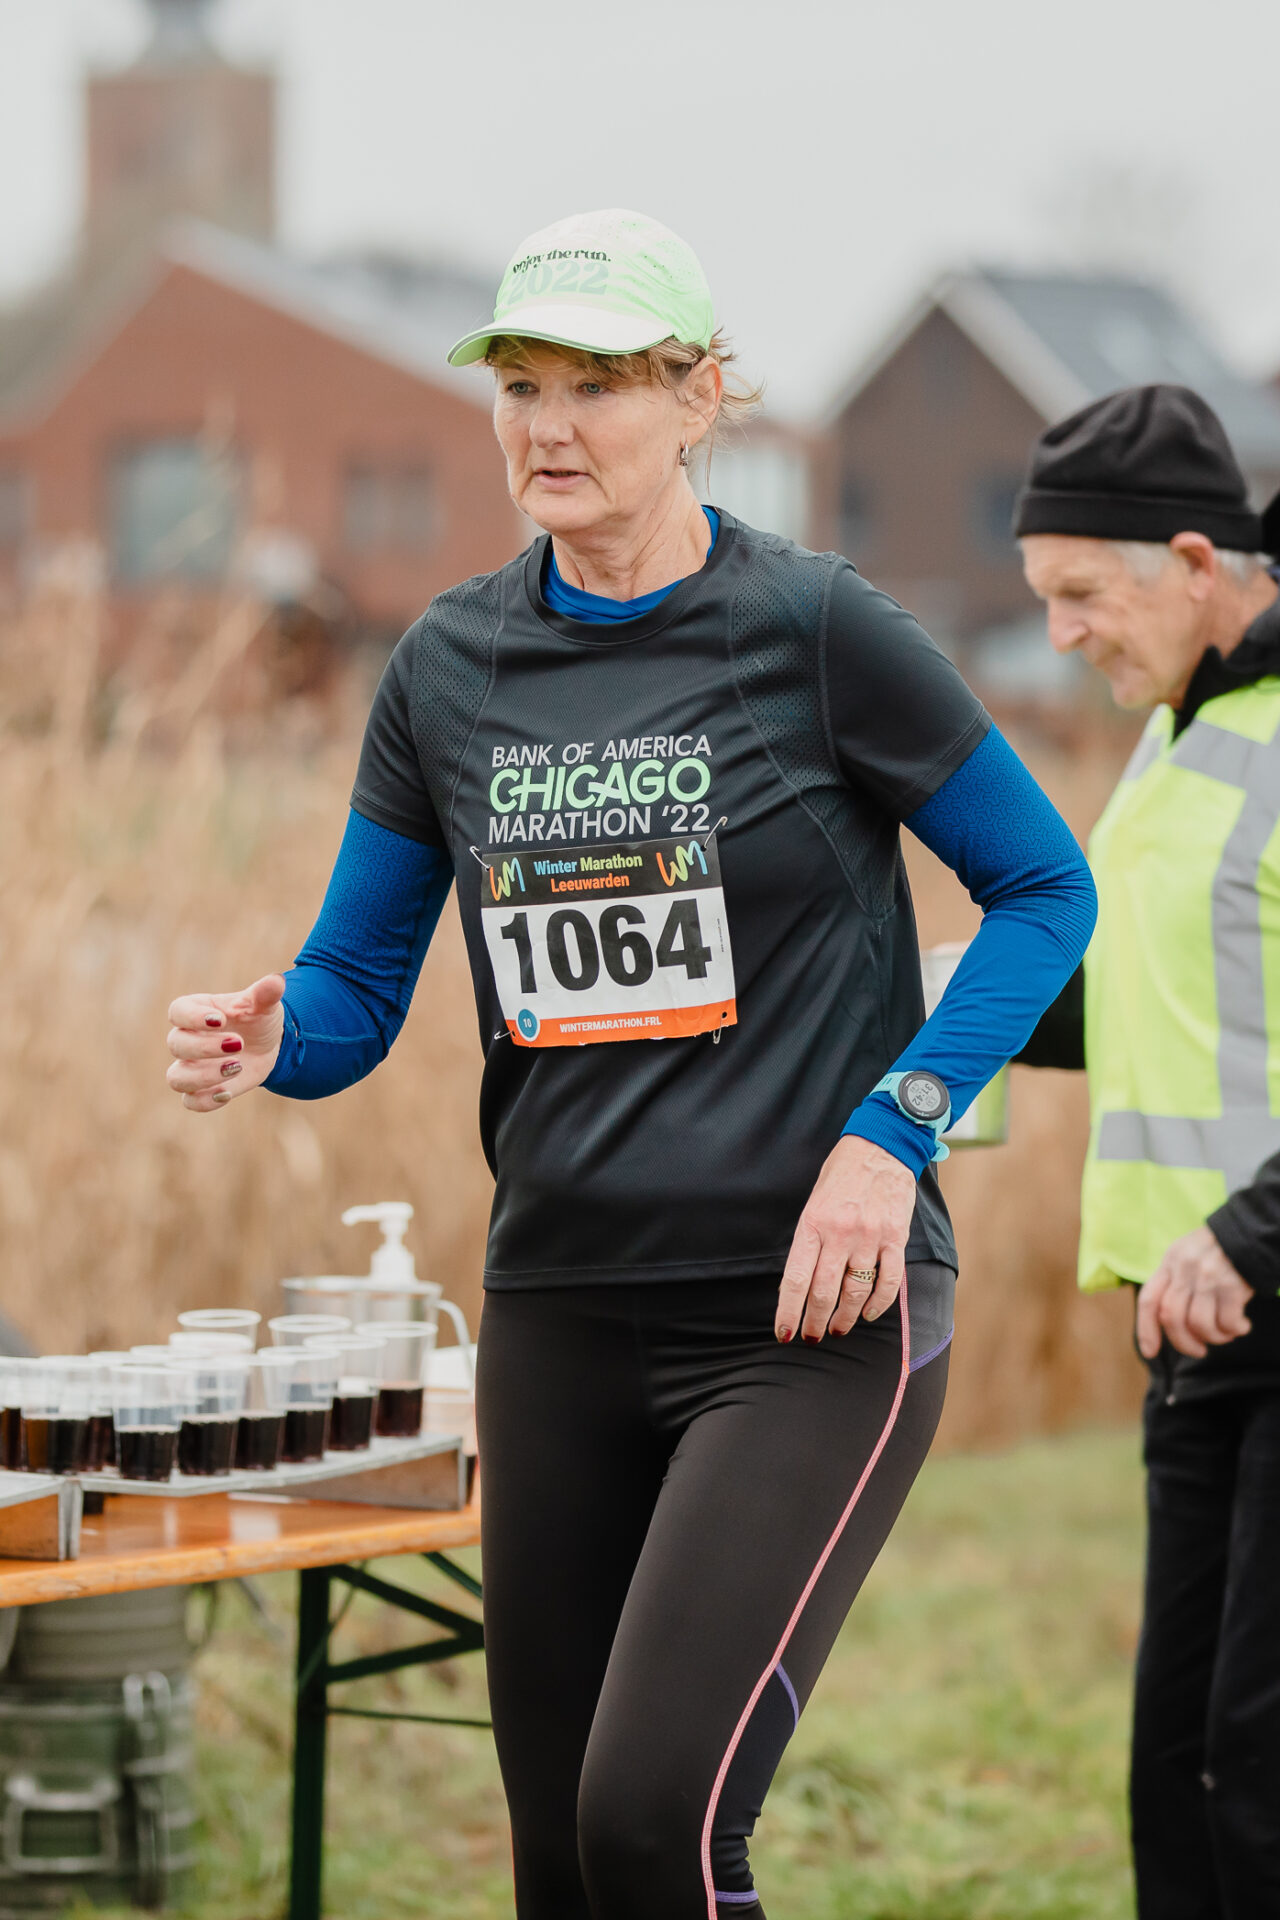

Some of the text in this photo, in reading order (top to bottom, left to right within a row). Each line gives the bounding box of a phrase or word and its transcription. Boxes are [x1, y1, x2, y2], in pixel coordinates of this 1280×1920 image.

[513, 249, 612, 274] enjoy the run.
[507, 260, 609, 305] 2022
[492, 734, 713, 768] BANK OF AMERICA
[489, 757, 711, 813] CHICAGO
[488, 803, 710, 844] MARATHON '22
[533, 853, 643, 876] Winter Marathon
[550, 873, 630, 893] Leeuwarden
[500, 898, 712, 994] 1064
[522, 1018, 532, 1028] 10
[559, 1016, 663, 1033] WINTERMARATHON.FRL
[912, 1083, 934, 1106] 31:42
